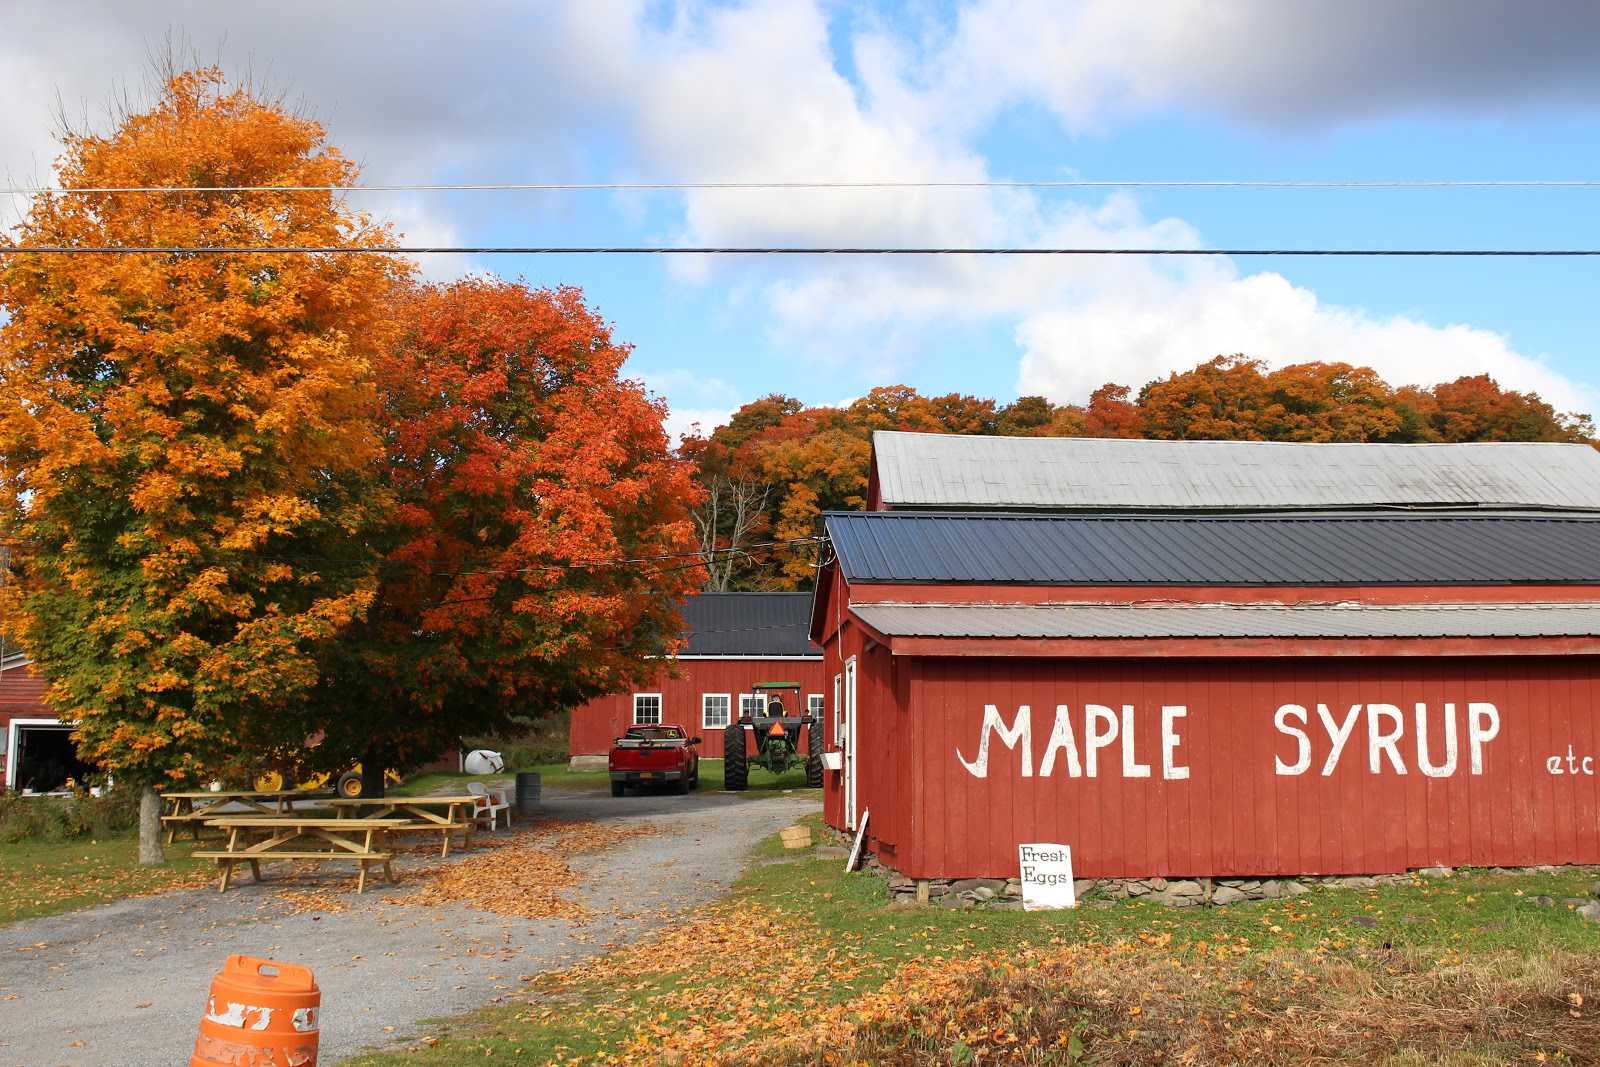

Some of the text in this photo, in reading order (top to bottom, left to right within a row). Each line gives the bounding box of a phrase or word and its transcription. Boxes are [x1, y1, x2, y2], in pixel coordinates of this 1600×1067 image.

[956, 702, 1594, 780] MAPLE SYRUP etc
[1020, 846, 1068, 862] Fresh
[1022, 866, 1068, 887] Eggs
